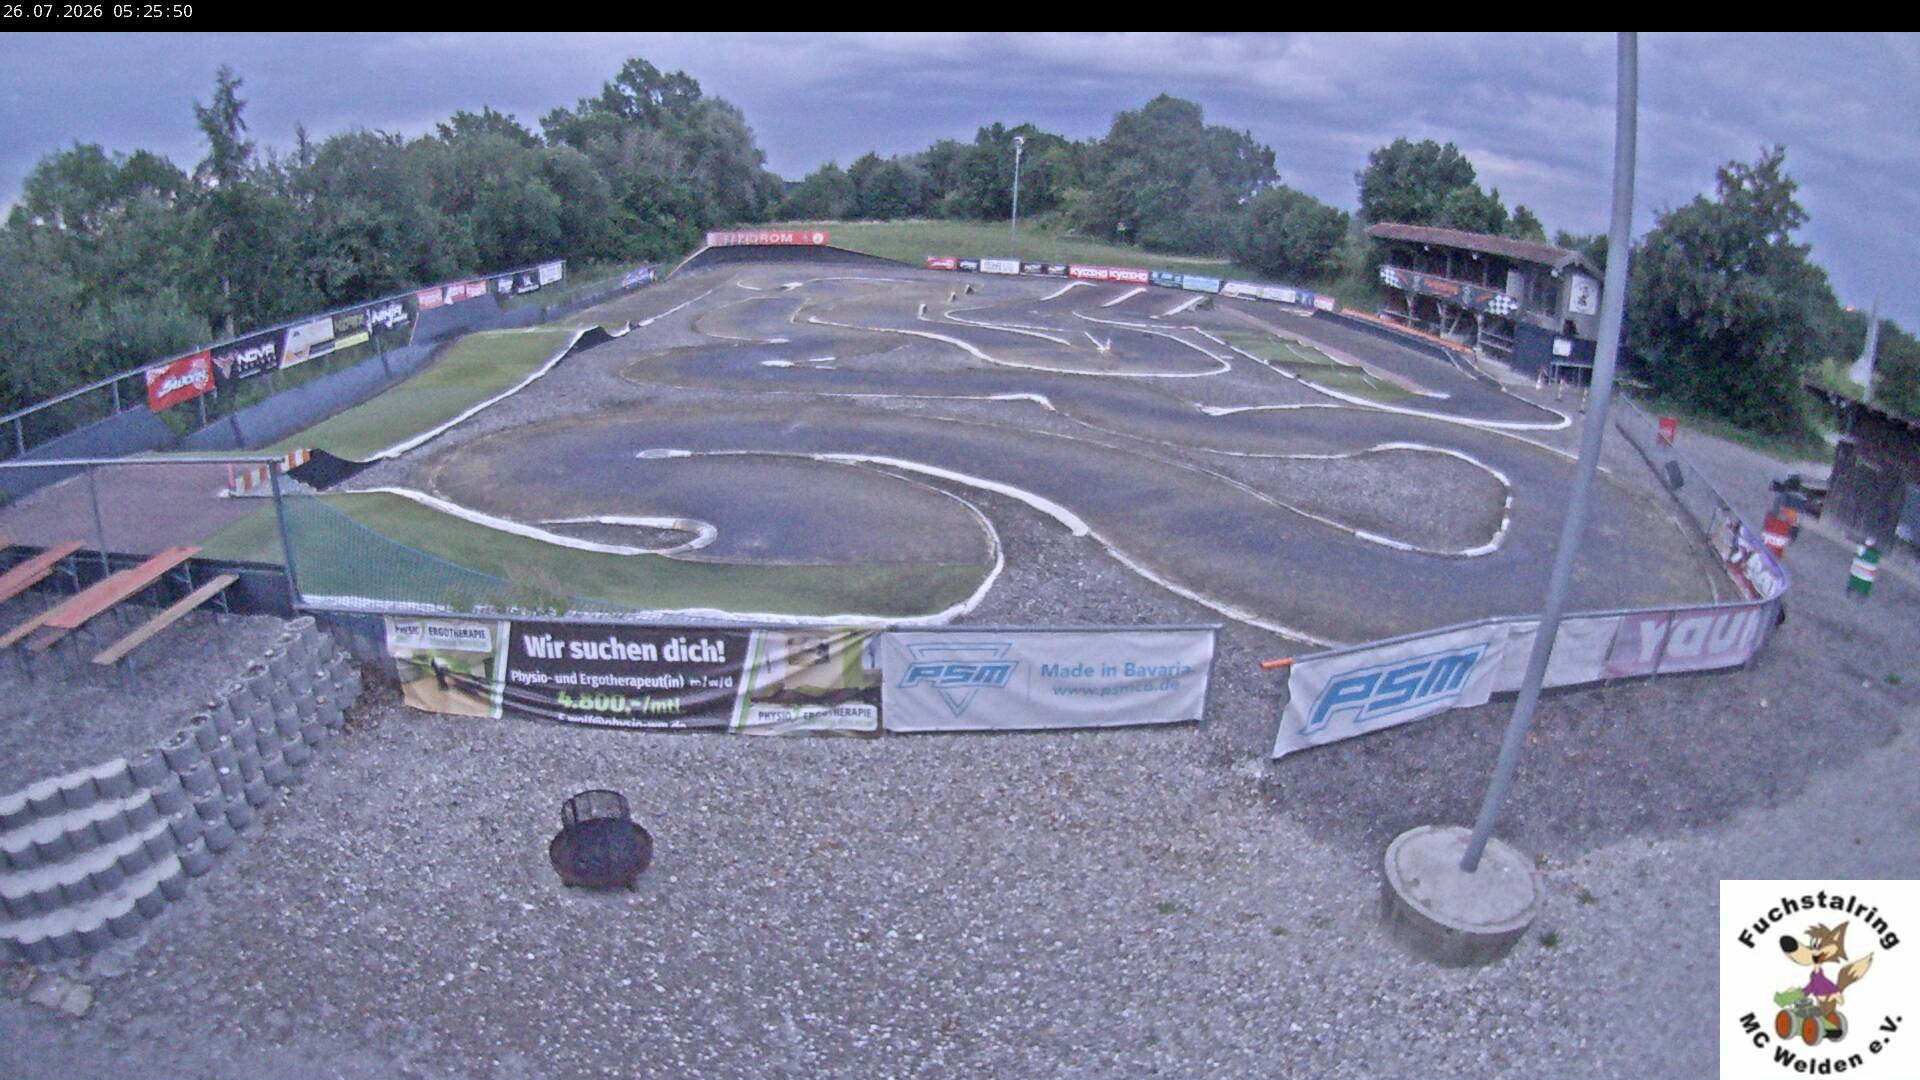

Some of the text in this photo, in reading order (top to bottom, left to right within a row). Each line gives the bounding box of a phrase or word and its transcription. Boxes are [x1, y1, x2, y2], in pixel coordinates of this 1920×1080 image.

[428, 626, 487, 640] ERGOTHERAPIE
[523, 634, 727, 664] Wir suchen dich!
[510, 669, 734, 690] Physio- und Ergotherapeut(in) m/w/d
[906, 664, 1012, 685] PSM
[1040, 661, 1194, 678] Made in Bavaria
[1308, 650, 1482, 727] PSM
[758, 711, 793, 722] PHYSIO
